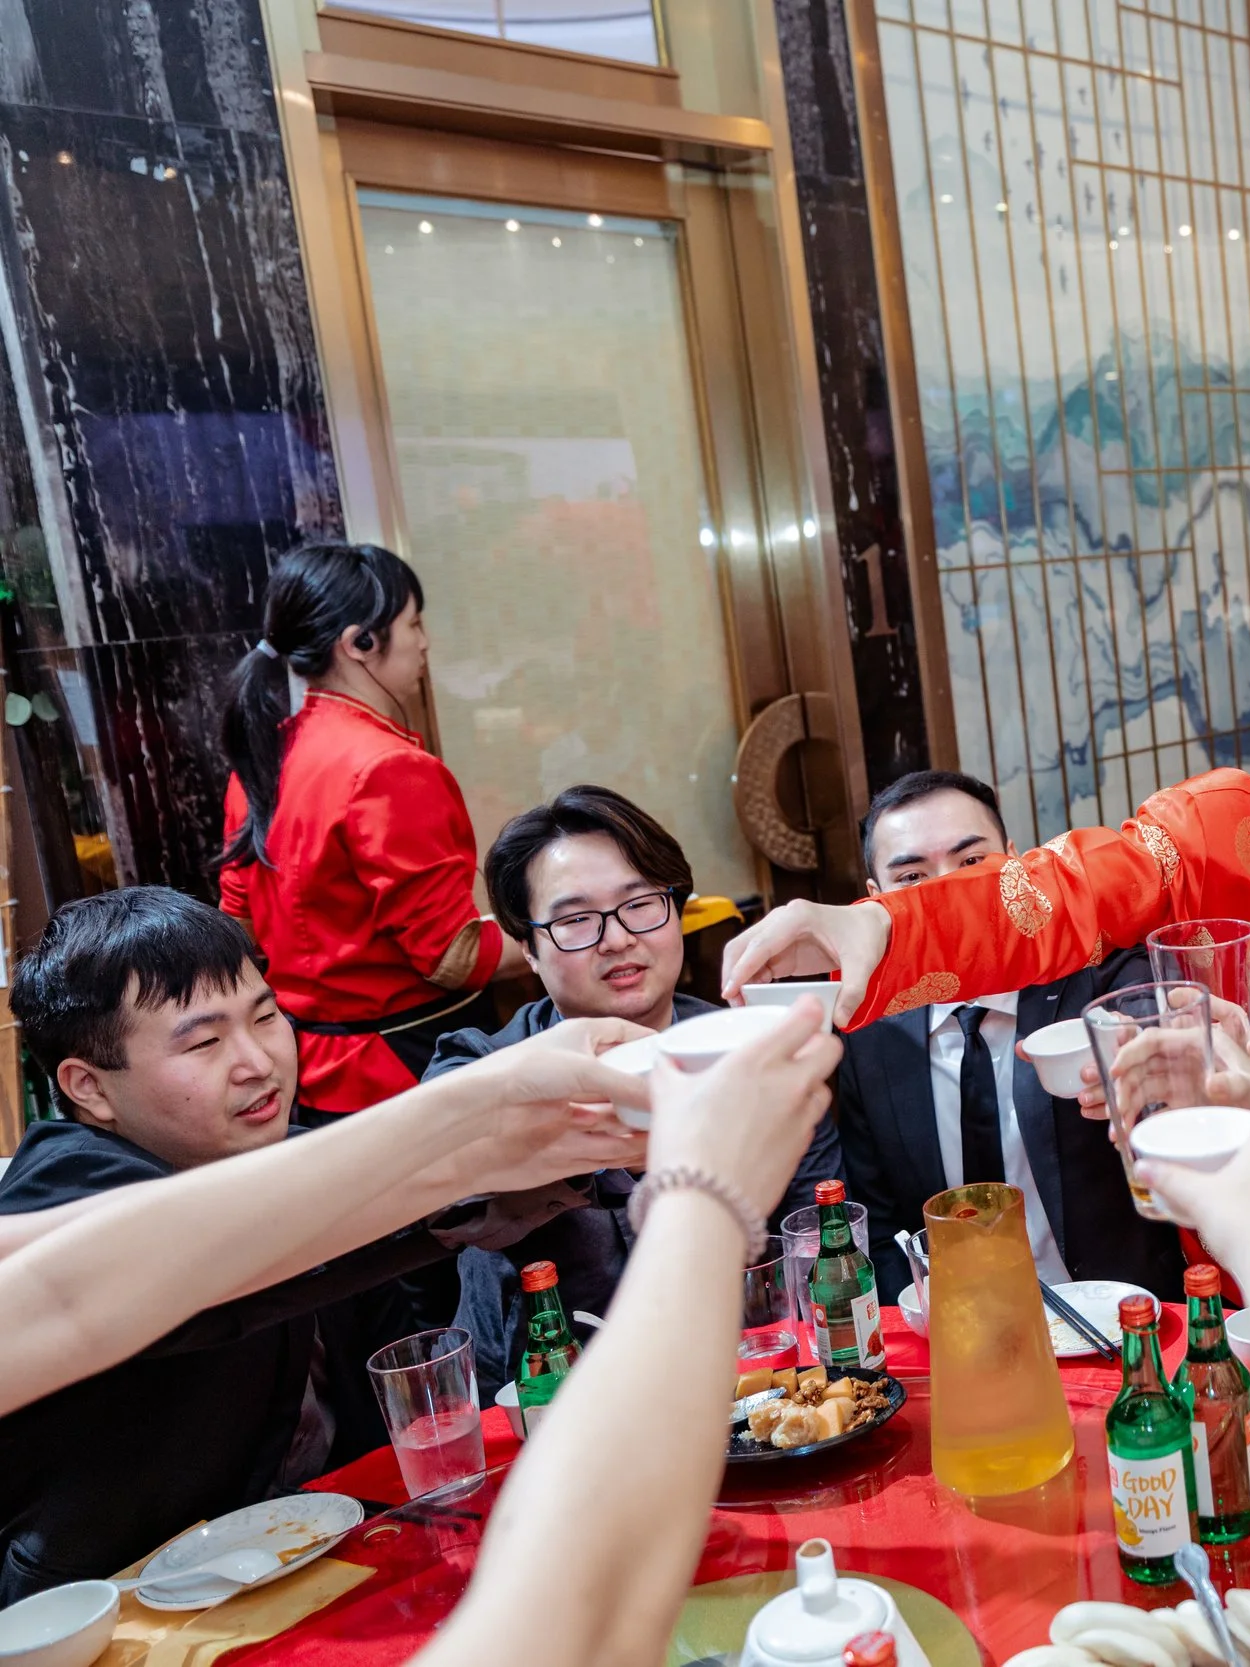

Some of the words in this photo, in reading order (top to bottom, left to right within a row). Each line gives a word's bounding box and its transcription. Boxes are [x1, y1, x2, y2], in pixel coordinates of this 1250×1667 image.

[856, 542, 899, 637] 1
[1122, 1467, 1177, 1494] GOOD
[1127, 1492, 1174, 1521] DAY
